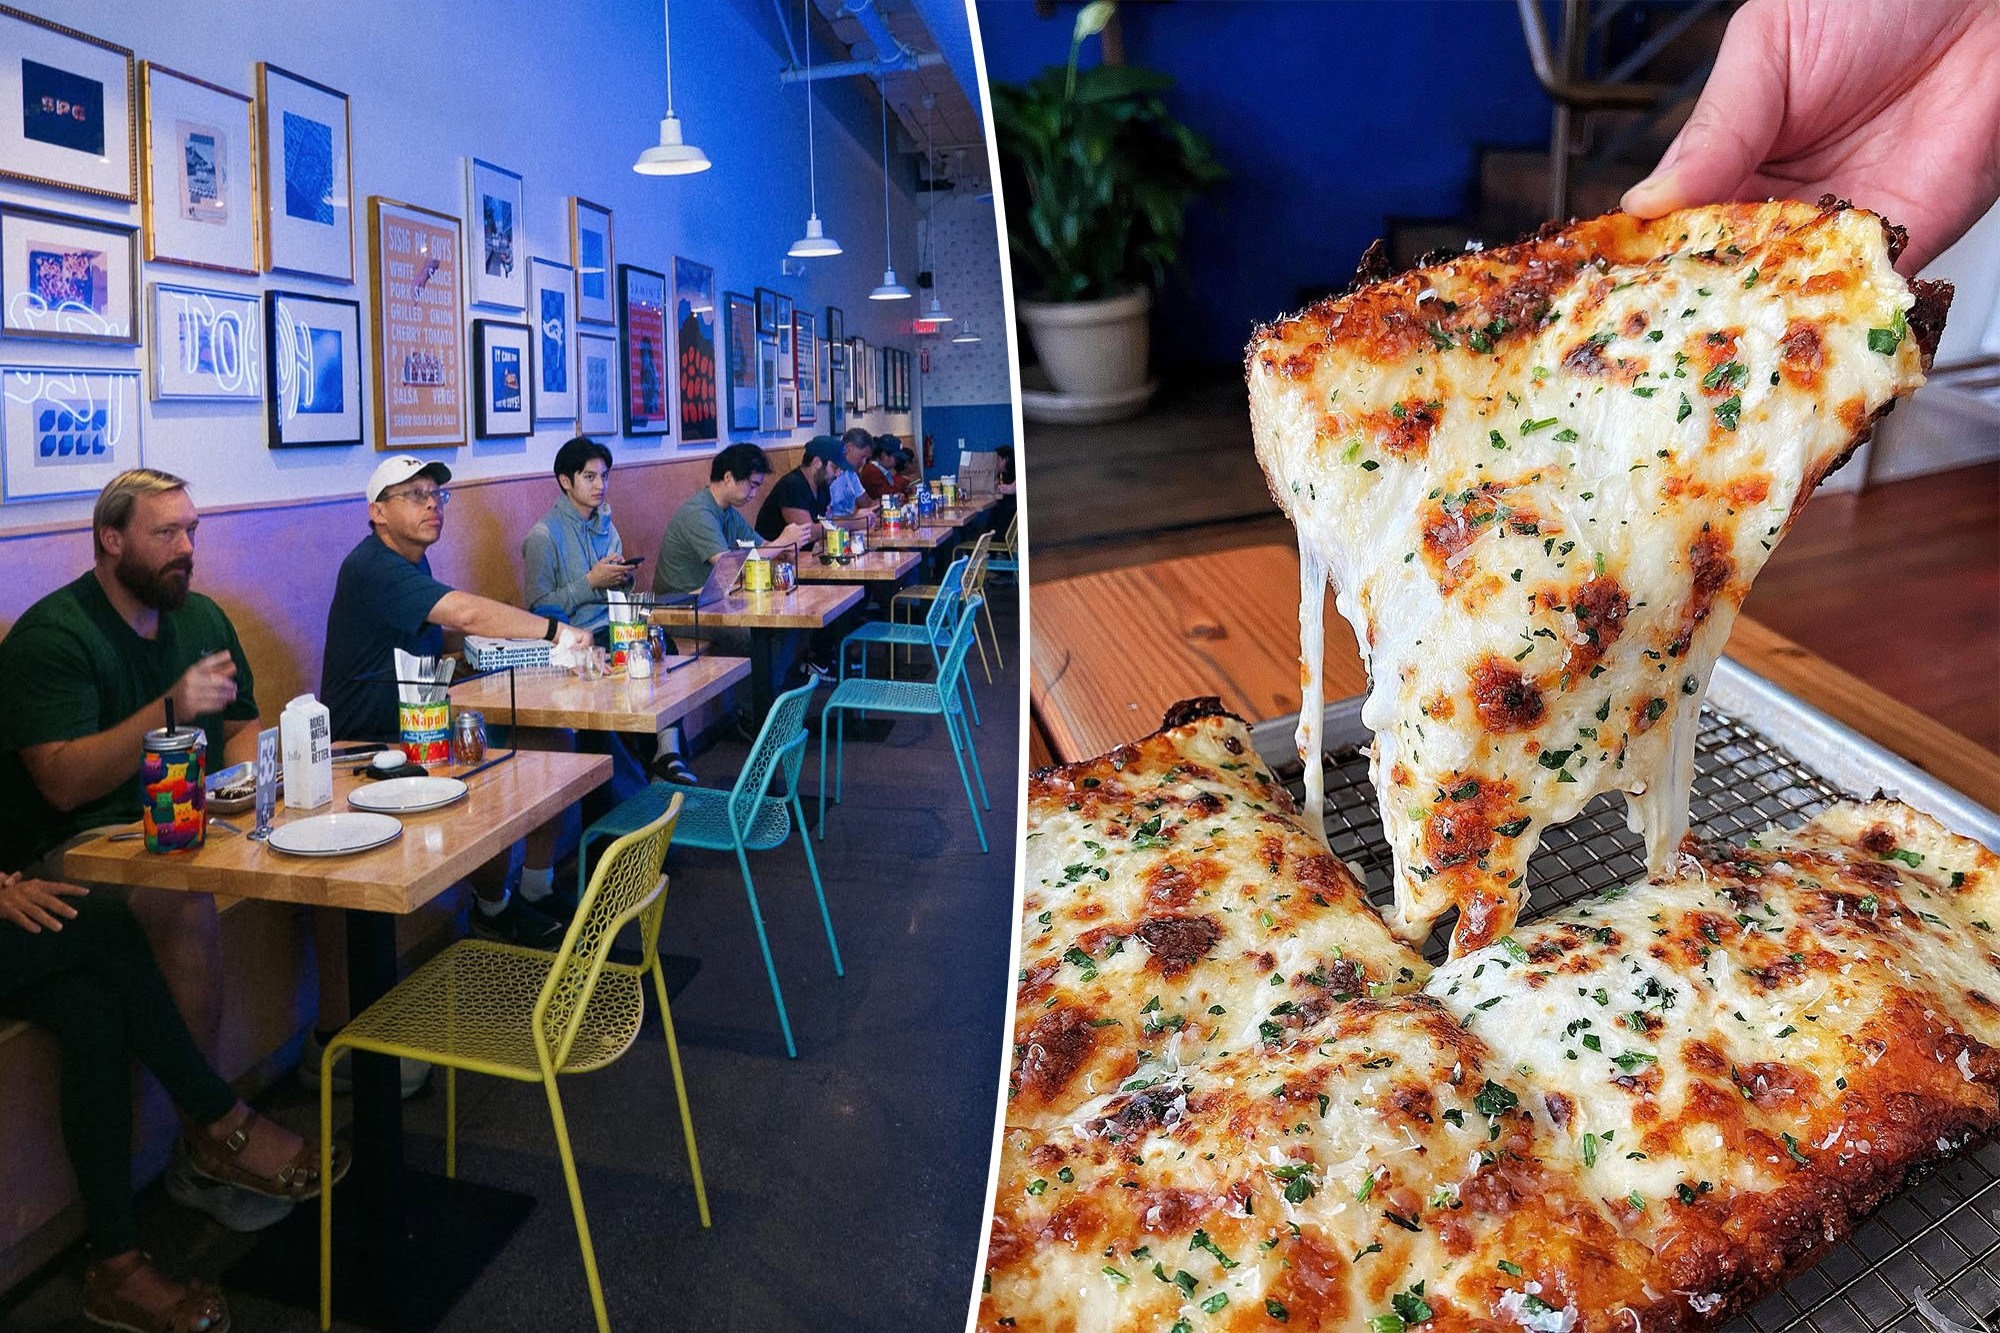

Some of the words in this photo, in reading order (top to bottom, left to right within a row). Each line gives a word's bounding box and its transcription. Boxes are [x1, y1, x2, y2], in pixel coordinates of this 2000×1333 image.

[389, 225, 410, 254] SISIG
[432, 235, 452, 262] GUYS
[390, 261, 414, 280] WHITE
[429, 267, 453, 287] SAUCE
[390, 282, 411, 300] PORK
[414, 286, 453, 306] SHOULDER
[391, 303, 423, 322] GRILLED
[430, 309, 453, 325] ONION
[392, 324, 422, 342] CHERRY
[424, 328, 454, 346] TOMATO
[393, 389, 419, 405] SALSA
[432, 389, 456, 405] VERDE
[310, 715, 325, 730] BOXED
[311, 727, 326, 741] WATER
[311, 740, 316, 752] IS
[258, 736, 276, 787] 58
